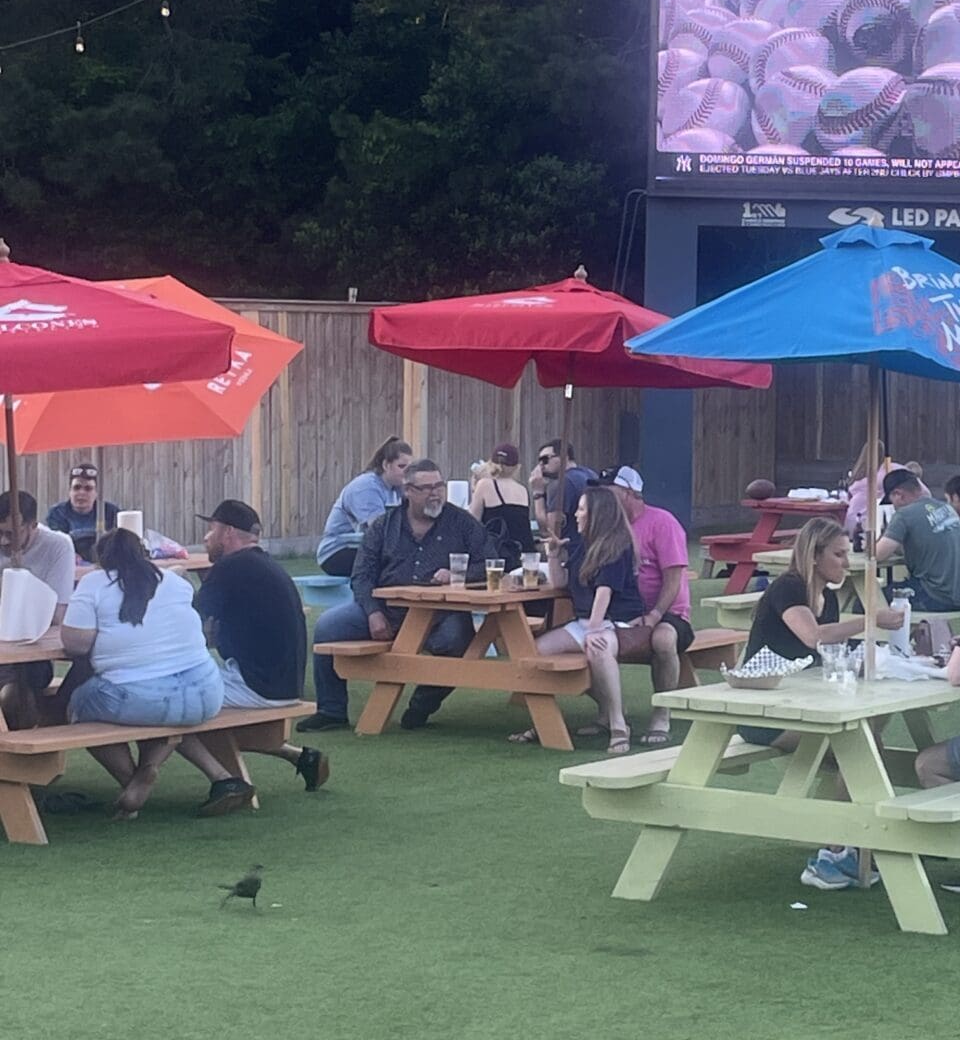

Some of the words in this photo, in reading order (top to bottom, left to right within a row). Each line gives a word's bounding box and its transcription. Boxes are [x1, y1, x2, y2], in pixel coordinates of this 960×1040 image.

[699, 154, 744, 164] DOMINGO
[786, 156, 841, 166] SUSPENDED
[843, 158, 853, 167] 10
[891, 158, 912, 168] WILL
[914, 159, 933, 169] NOT
[892, 207, 929, 227] LED
